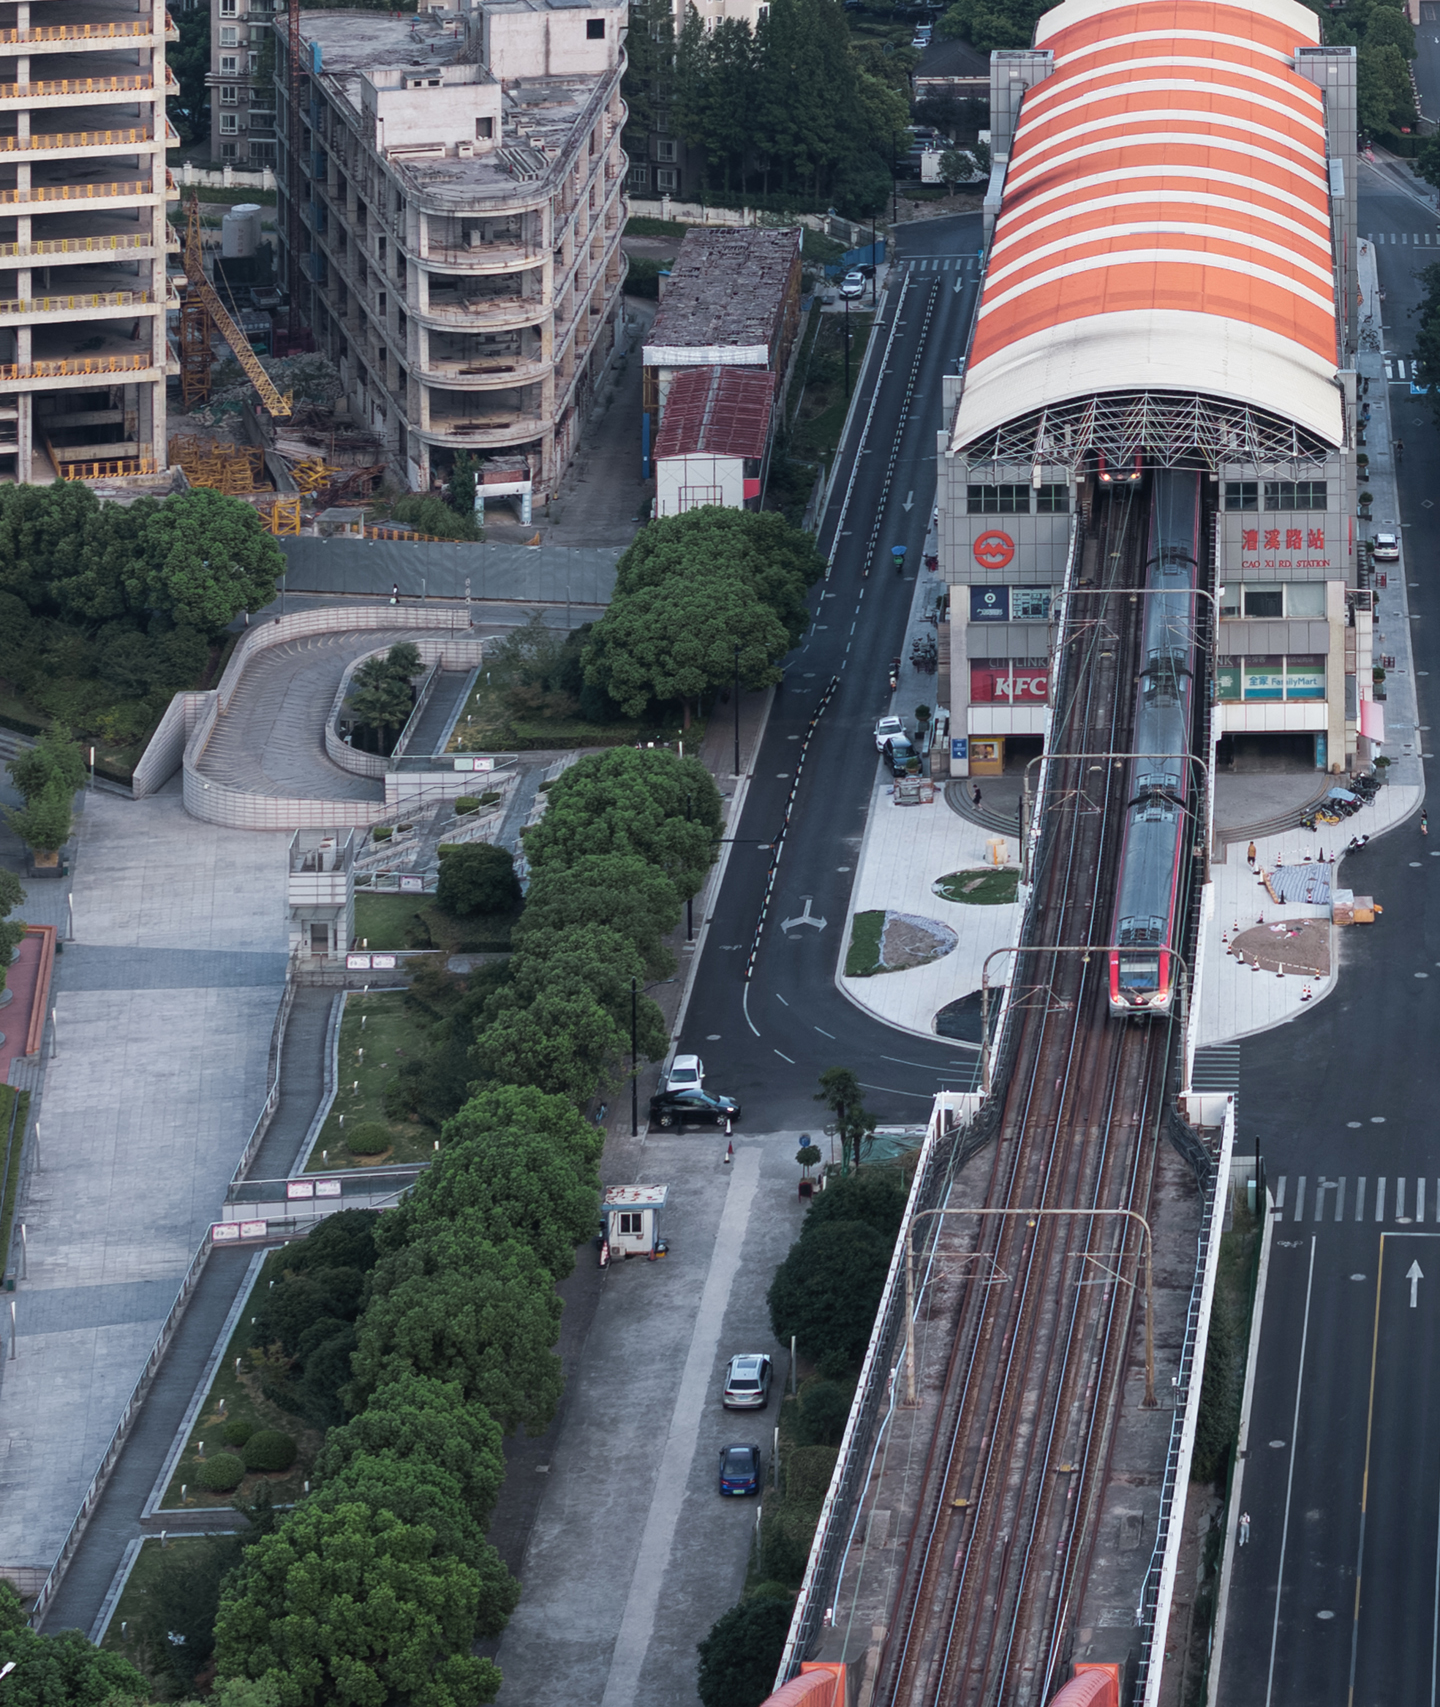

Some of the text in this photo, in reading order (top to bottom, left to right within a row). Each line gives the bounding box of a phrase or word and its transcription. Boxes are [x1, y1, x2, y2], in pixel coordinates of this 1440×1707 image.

[1242, 528, 1325, 551] 漕溪路站
[1242, 560, 1260, 569] CAO
[1264, 559, 1275, 568] XI
[1296, 558, 1331, 568] STATION
[988, 656, 1047, 669] CITLINK
[994, 677, 1047, 696] KFC
[1249, 675, 1269, 687] 全家
